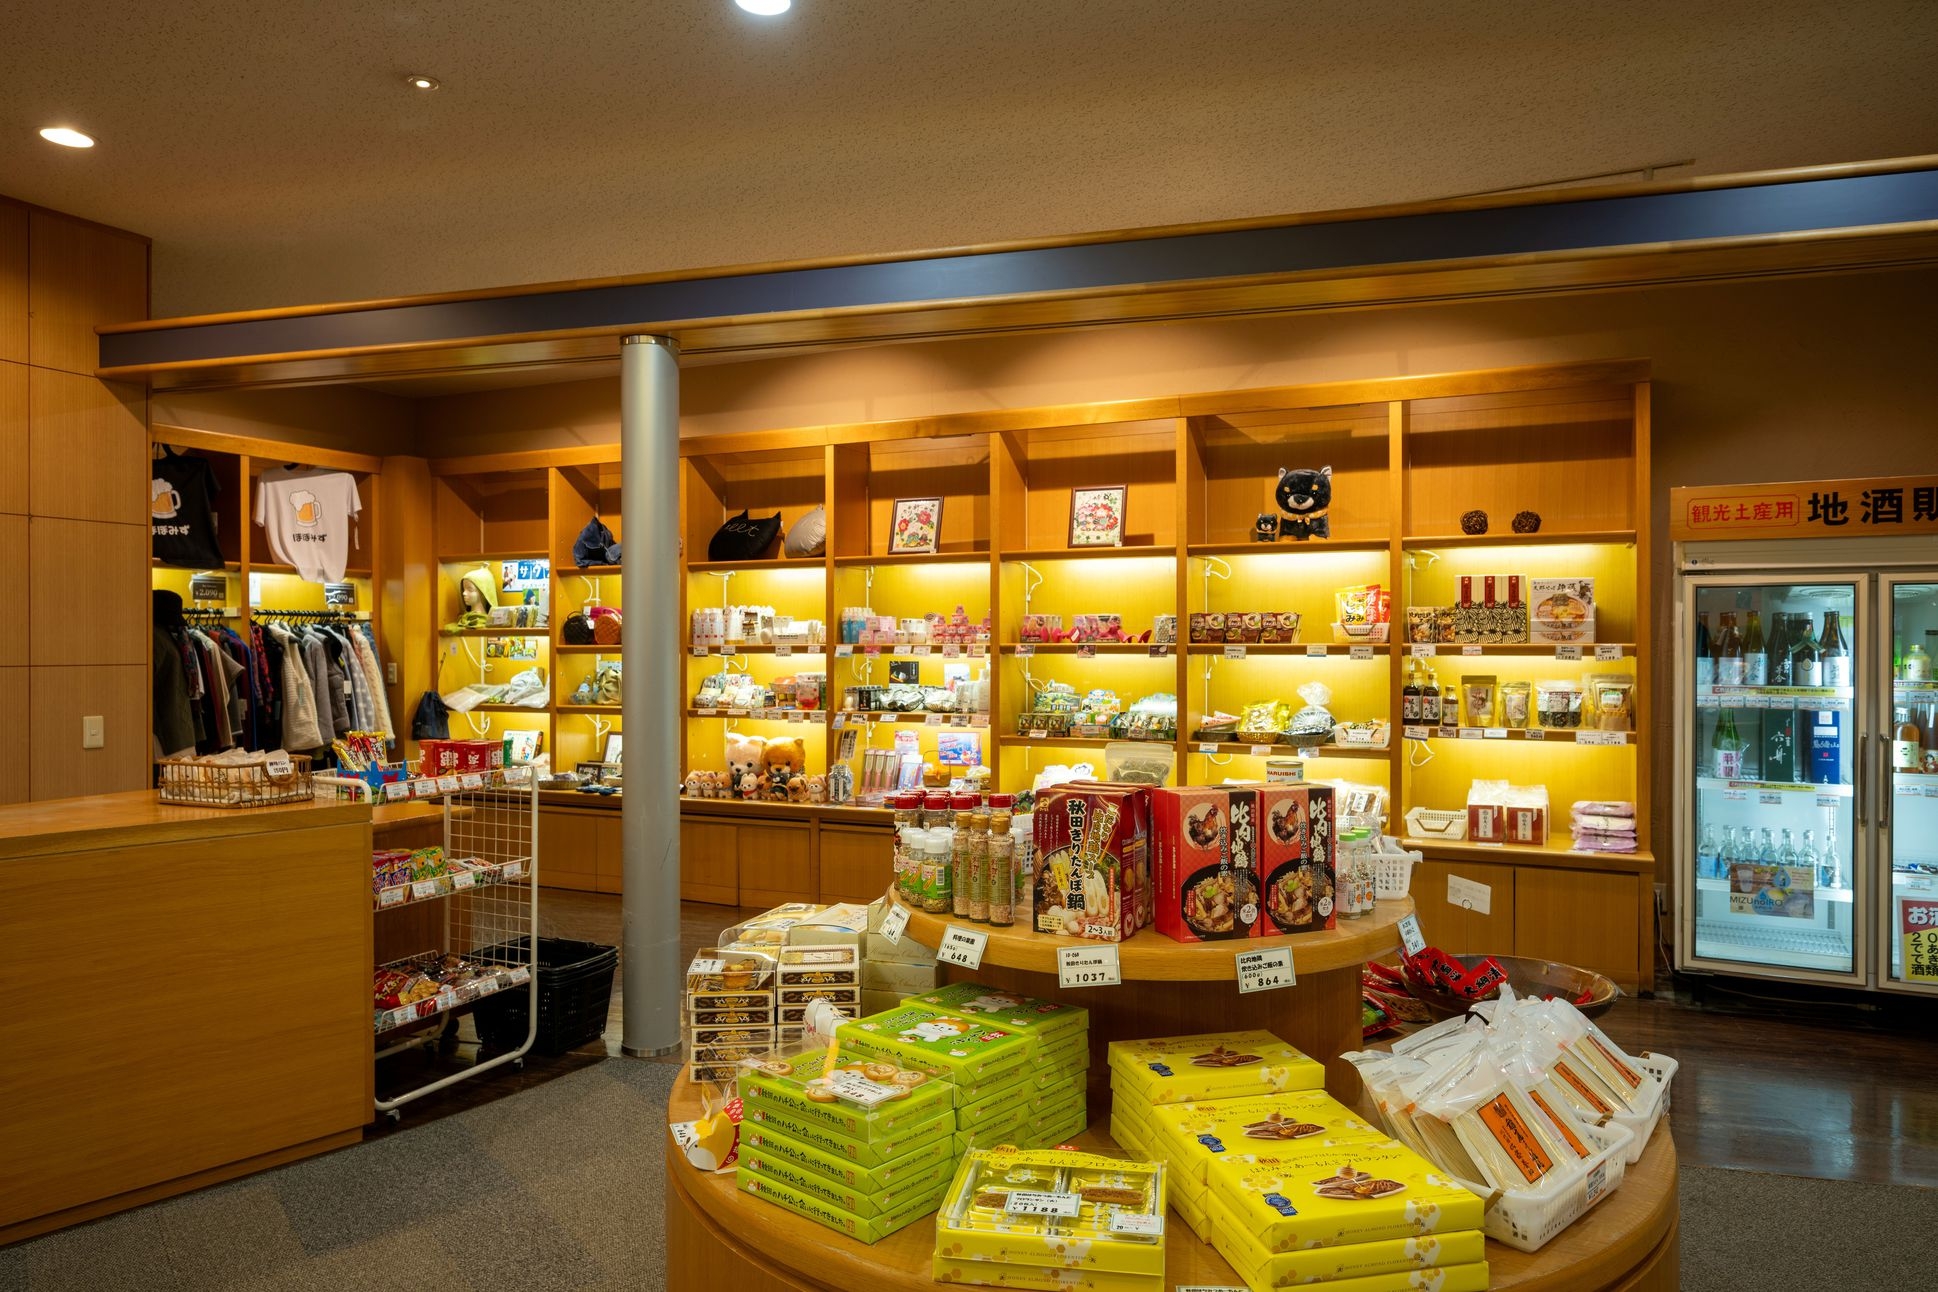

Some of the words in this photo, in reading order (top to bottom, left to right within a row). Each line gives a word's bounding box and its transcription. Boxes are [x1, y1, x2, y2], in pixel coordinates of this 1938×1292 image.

[1692, 501, 1794, 524] 観光土産用
[1230, 801, 1251, 868] 比内地鶏
[1309, 797, 1327, 863] 比内地鶏
[1067, 800, 1087, 911] 秋田きりたんぽ鍋
[951, 952, 968, 963] 648
[1066, 959, 1103, 967] 秋田きりたんぽ鍋
[1240, 956, 1263, 964] 比内地鶏
[1241, 960, 1284, 973] 炊き込みご飯の素
[1075, 973, 1105, 982] 1037
[1258, 976, 1279, 987] 864
